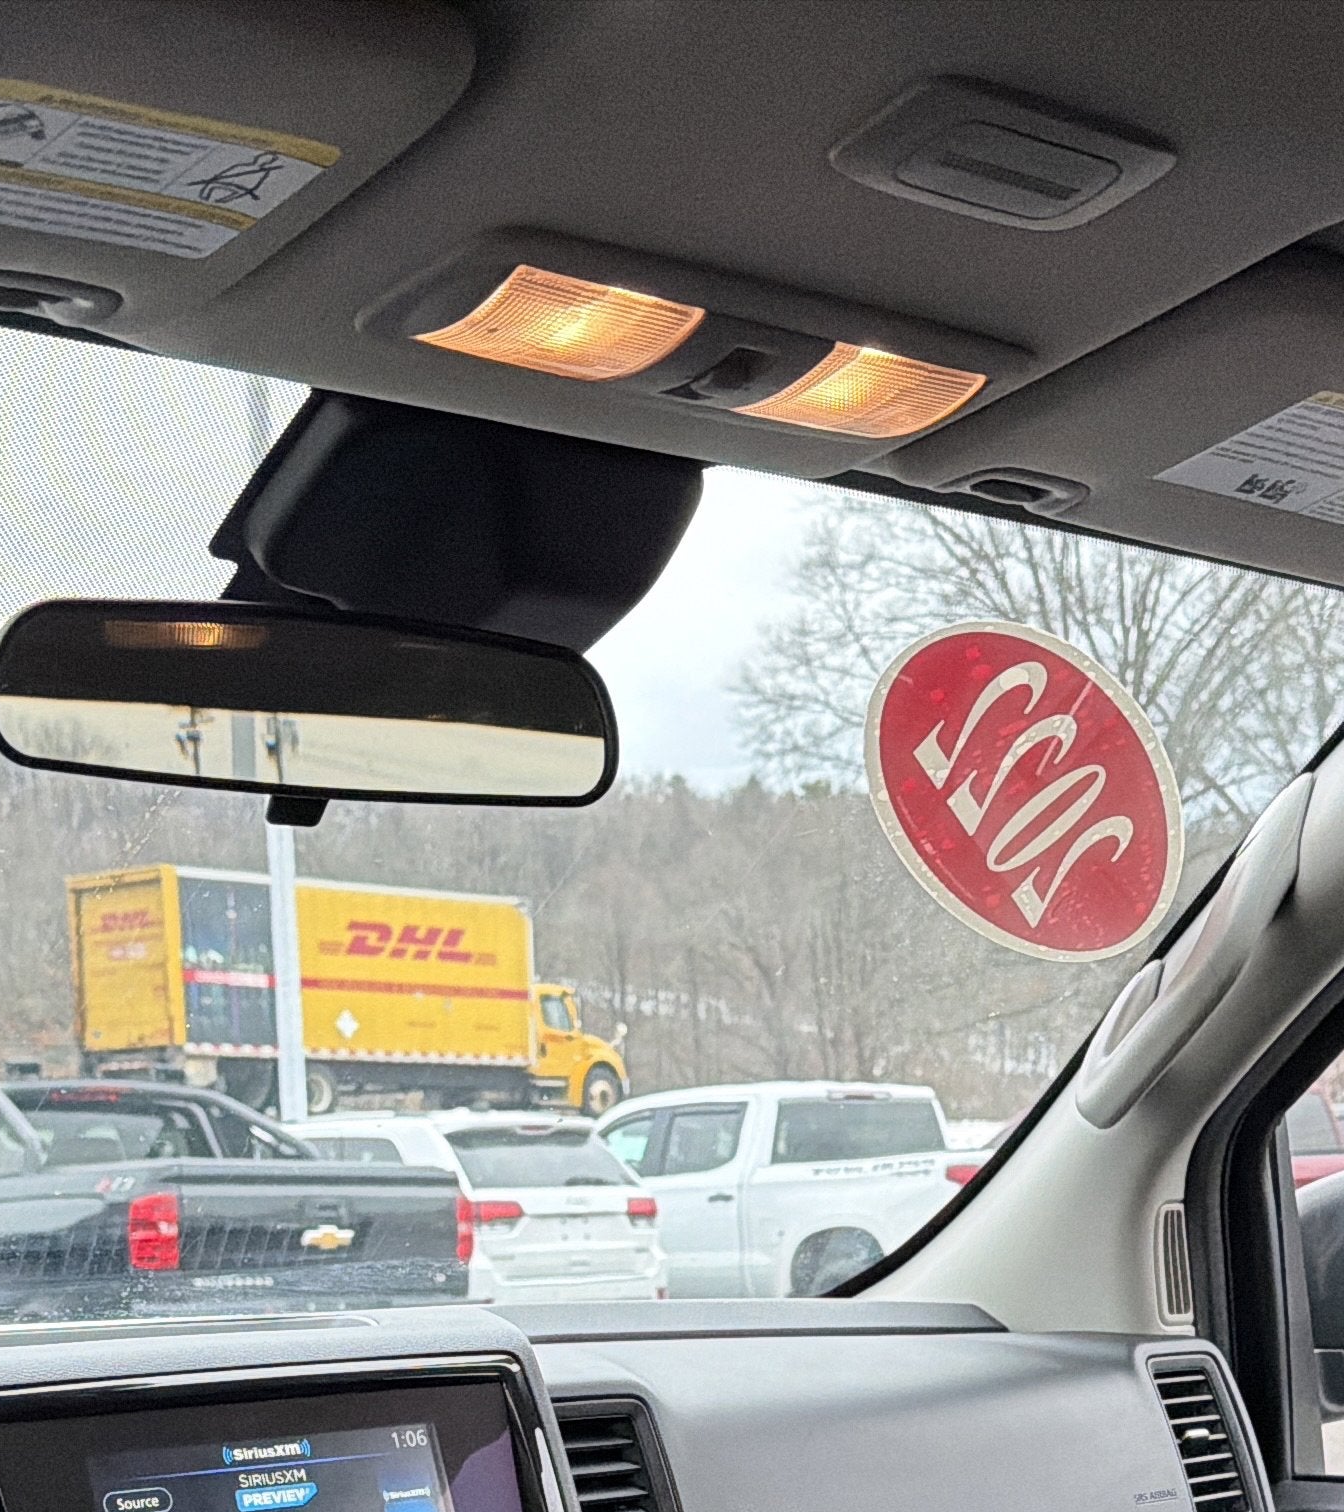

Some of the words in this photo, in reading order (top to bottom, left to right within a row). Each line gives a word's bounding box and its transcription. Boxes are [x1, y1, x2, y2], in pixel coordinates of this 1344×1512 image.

[346, 921, 474, 964] DHL
[391, 1429, 428, 1449] 1:06
[238, 1468, 308, 1488] SIRIUSXM
[116, 1496, 160, 1511] Source
